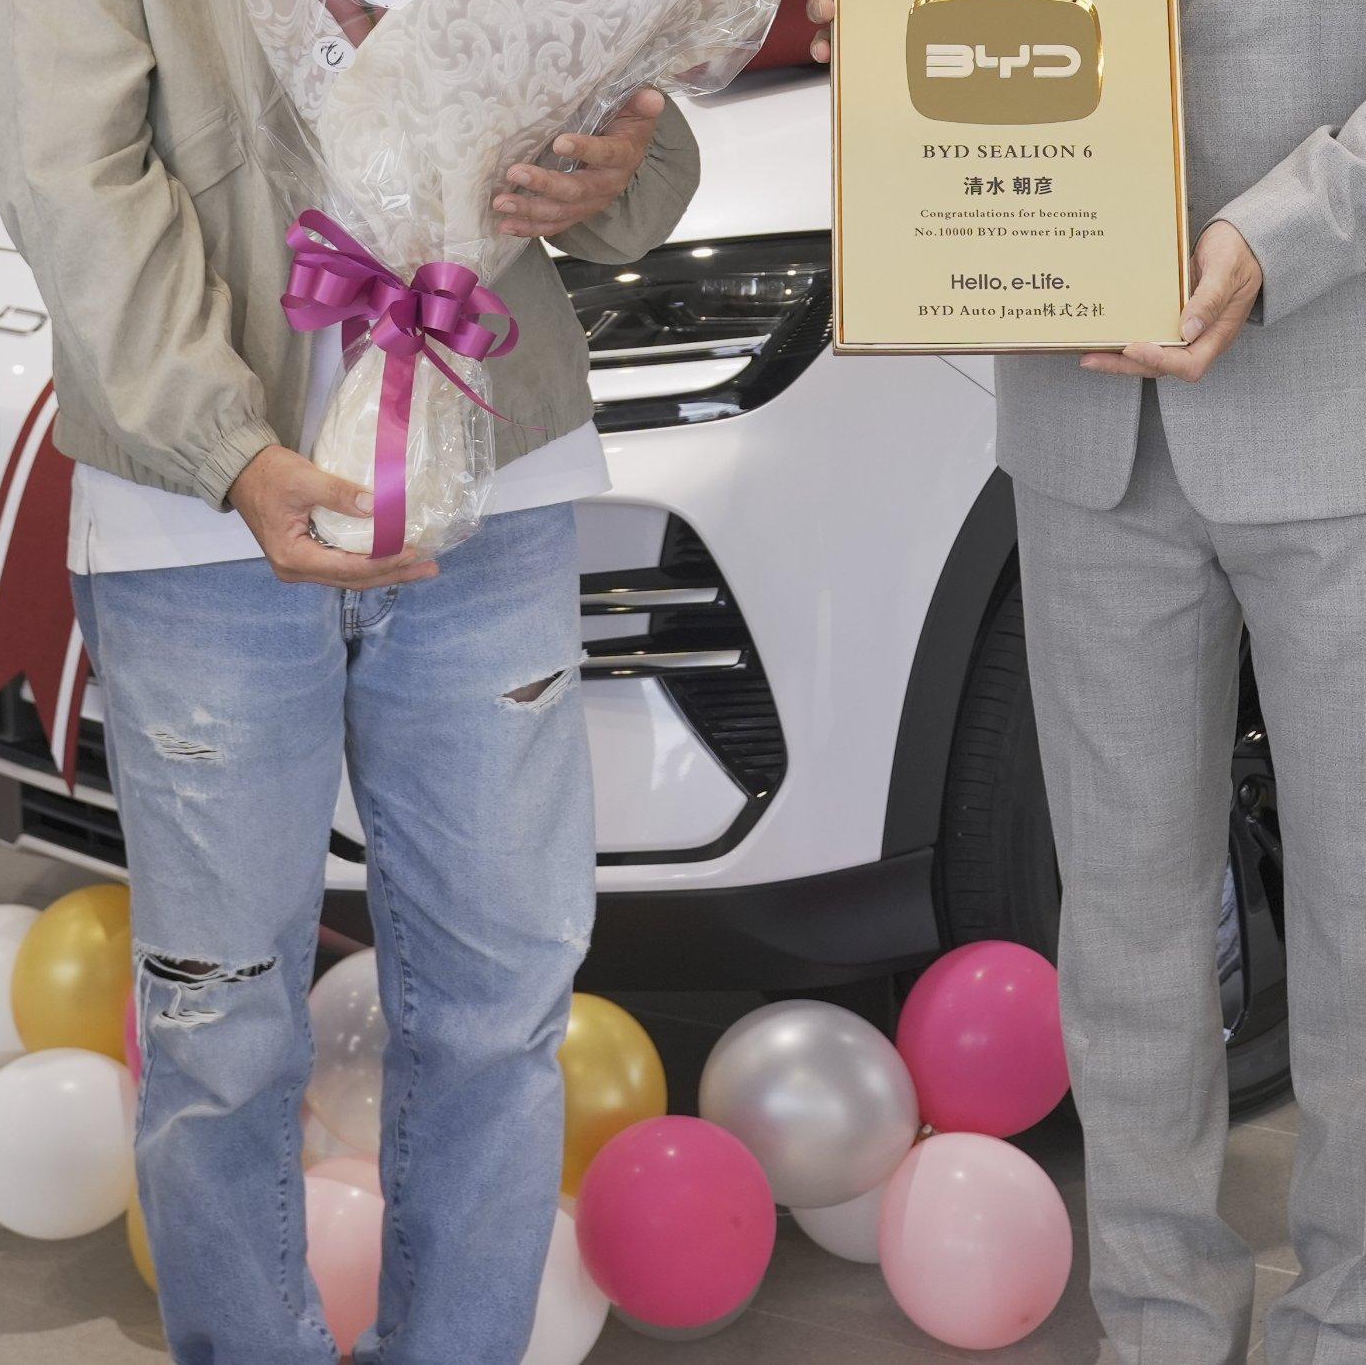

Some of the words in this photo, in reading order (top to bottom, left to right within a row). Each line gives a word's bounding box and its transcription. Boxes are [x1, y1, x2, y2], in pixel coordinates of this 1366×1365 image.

[925, 43, 1082, 79] BYD
[922, 144, 970, 159] BYD
[977, 144, 1076, 159] SEALION
[1083, 144, 1094, 159] 6
[963, 176, 1006, 196] 清水
[1011, 175, 1054, 196] 朝彦
[920, 208, 1015, 221] Congratulations
[1018, 208, 1036, 219] for
[1039, 208, 1098, 220] becoming
[914, 227, 973, 237] No.10000
[977, 226, 1008, 237] BYD
[1011, 229, 1051, 237] owner
[1054, 226, 1066, 237] in
[1068, 227, 1105, 239] Japan
[951, 273, 1008, 291] Hello,
[1011, 272, 1071, 291] e-Life.
[917, 305, 954, 317] BYD
[959, 305, 996, 317] Auto
